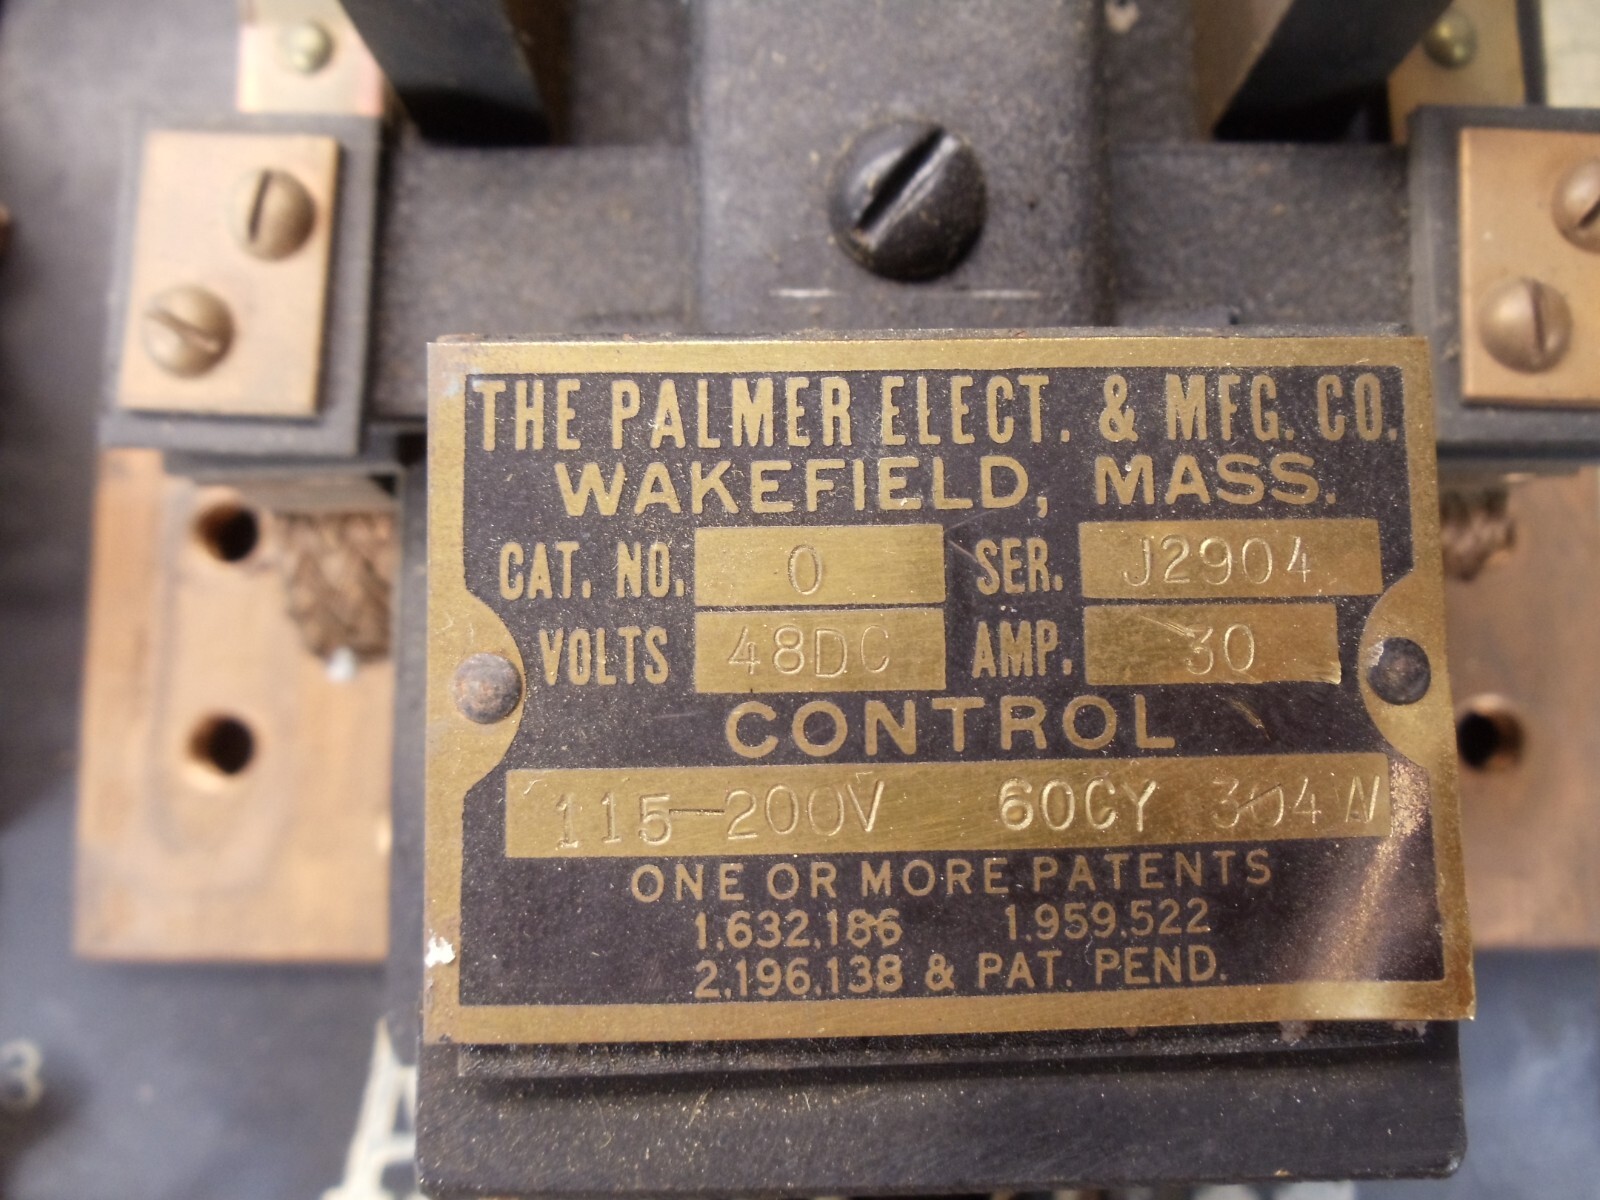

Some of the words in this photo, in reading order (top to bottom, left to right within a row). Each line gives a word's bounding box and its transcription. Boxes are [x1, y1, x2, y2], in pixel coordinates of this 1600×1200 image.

[473, 378, 581, 452] THE
[611, 376, 854, 450] PALMER
[879, 373, 1070, 446] ELECT.
[1100, 374, 1137, 443] &
[1165, 373, 1295, 443] MFG.
[1316, 372, 1398, 442] CO.
[553, 455, 1049, 518] WAKEFIELD,
[1094, 452, 1337, 506] MASS.
[500, 541, 592, 600] CAT.
[617, 541, 685, 599] NO.
[975, 537, 1064, 596] SER.
[1121, 534, 1312, 588] J2904
[539, 625, 668, 686] VOLTS
[727, 624, 890, 679] 48DC
[972, 621, 1073, 679] AMP.
[1181, 622, 1255, 675] 30
[725, 695, 1176, 759] CONTROL
[997, 776, 1158, 833] 60CY
[631, 860, 745, 902] ONE
[766, 862, 837, 901] OR
[861, 856, 1009, 899] MORE
[1033, 848, 1273, 893] PATENTS
[925, 953, 955, 991] &
[978, 950, 1074, 990] PAT.
[1095, 944, 1228, 985] PEND.
